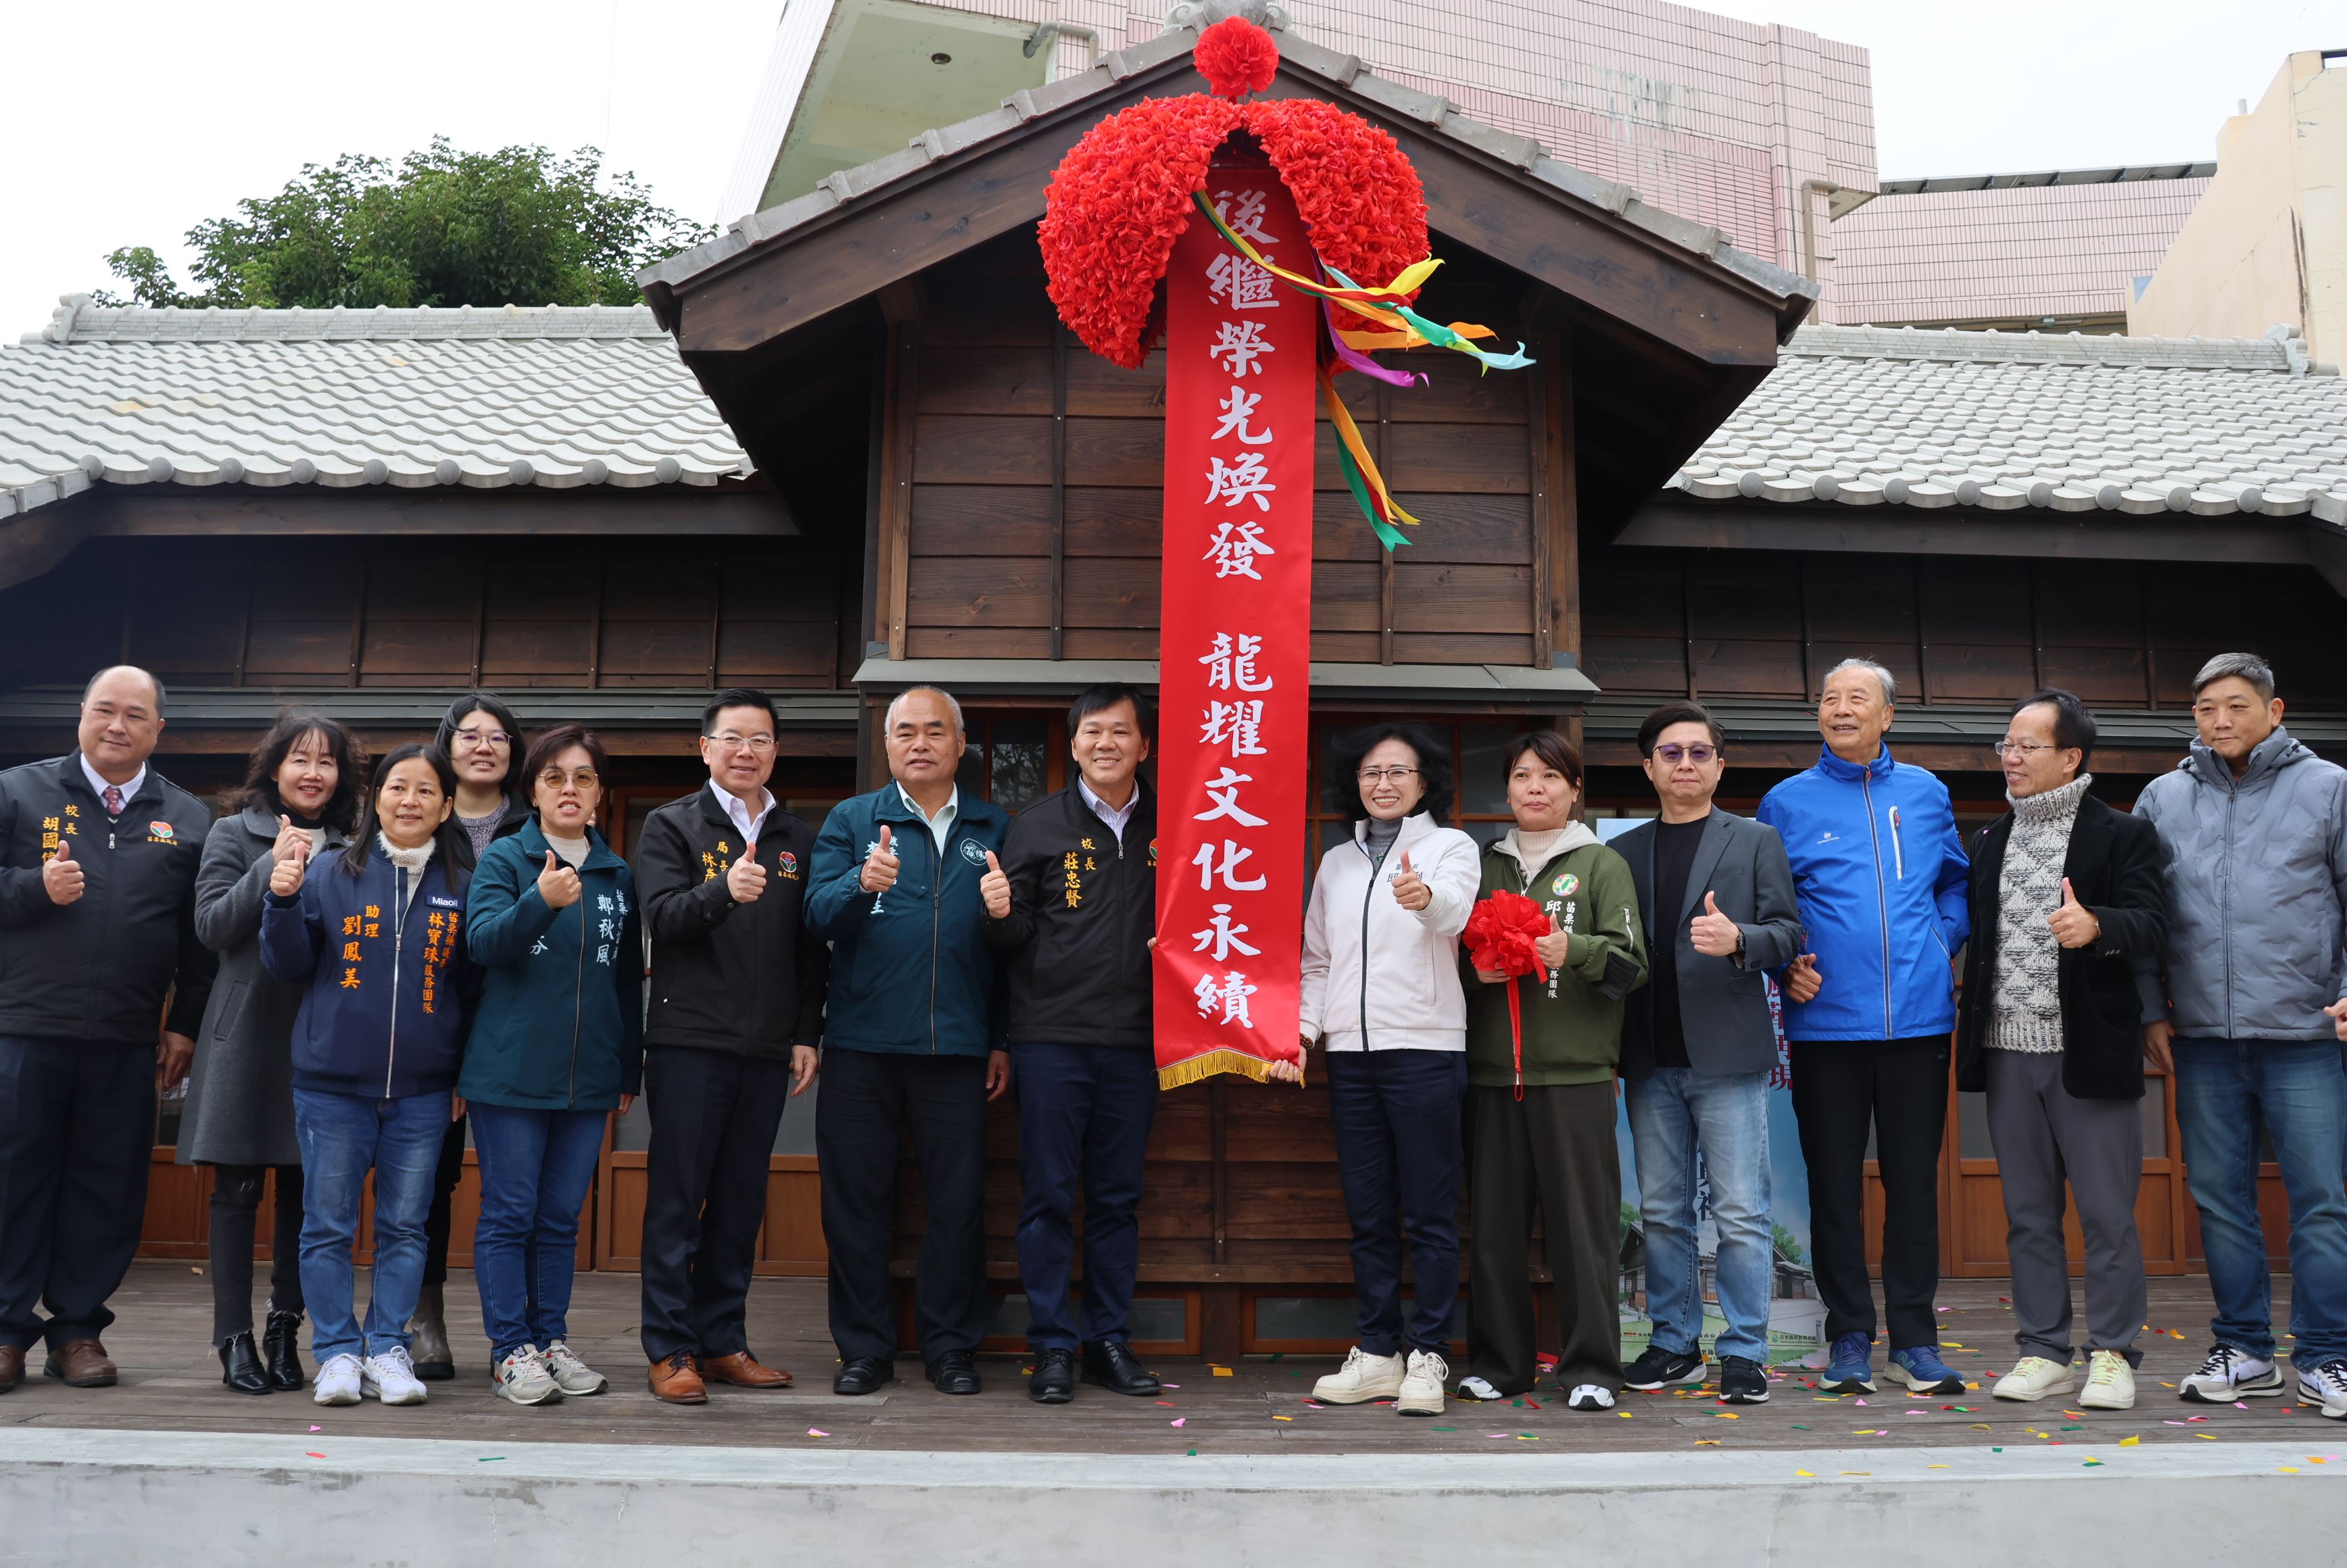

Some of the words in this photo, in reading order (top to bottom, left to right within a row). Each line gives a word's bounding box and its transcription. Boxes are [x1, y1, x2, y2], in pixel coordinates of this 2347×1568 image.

[1203, 189, 1280, 580] 後繼榮光煥發
[65, 804, 80, 835] 校長
[1192, 632, 1273, 1029] 龍耀文化永續
[717, 841, 729, 872] 局長
[1063, 852, 1082, 908] 莊忠賢
[1081, 838, 1096, 871] 校長
[364, 905, 381, 937] 助理
[432, 896, 458, 908] Miaoli
[596, 894, 614, 966] 鄭秋風
[339, 914, 362, 989] 劉鳳美
[422, 912, 445, 1014] 林寶珠服務團隊
